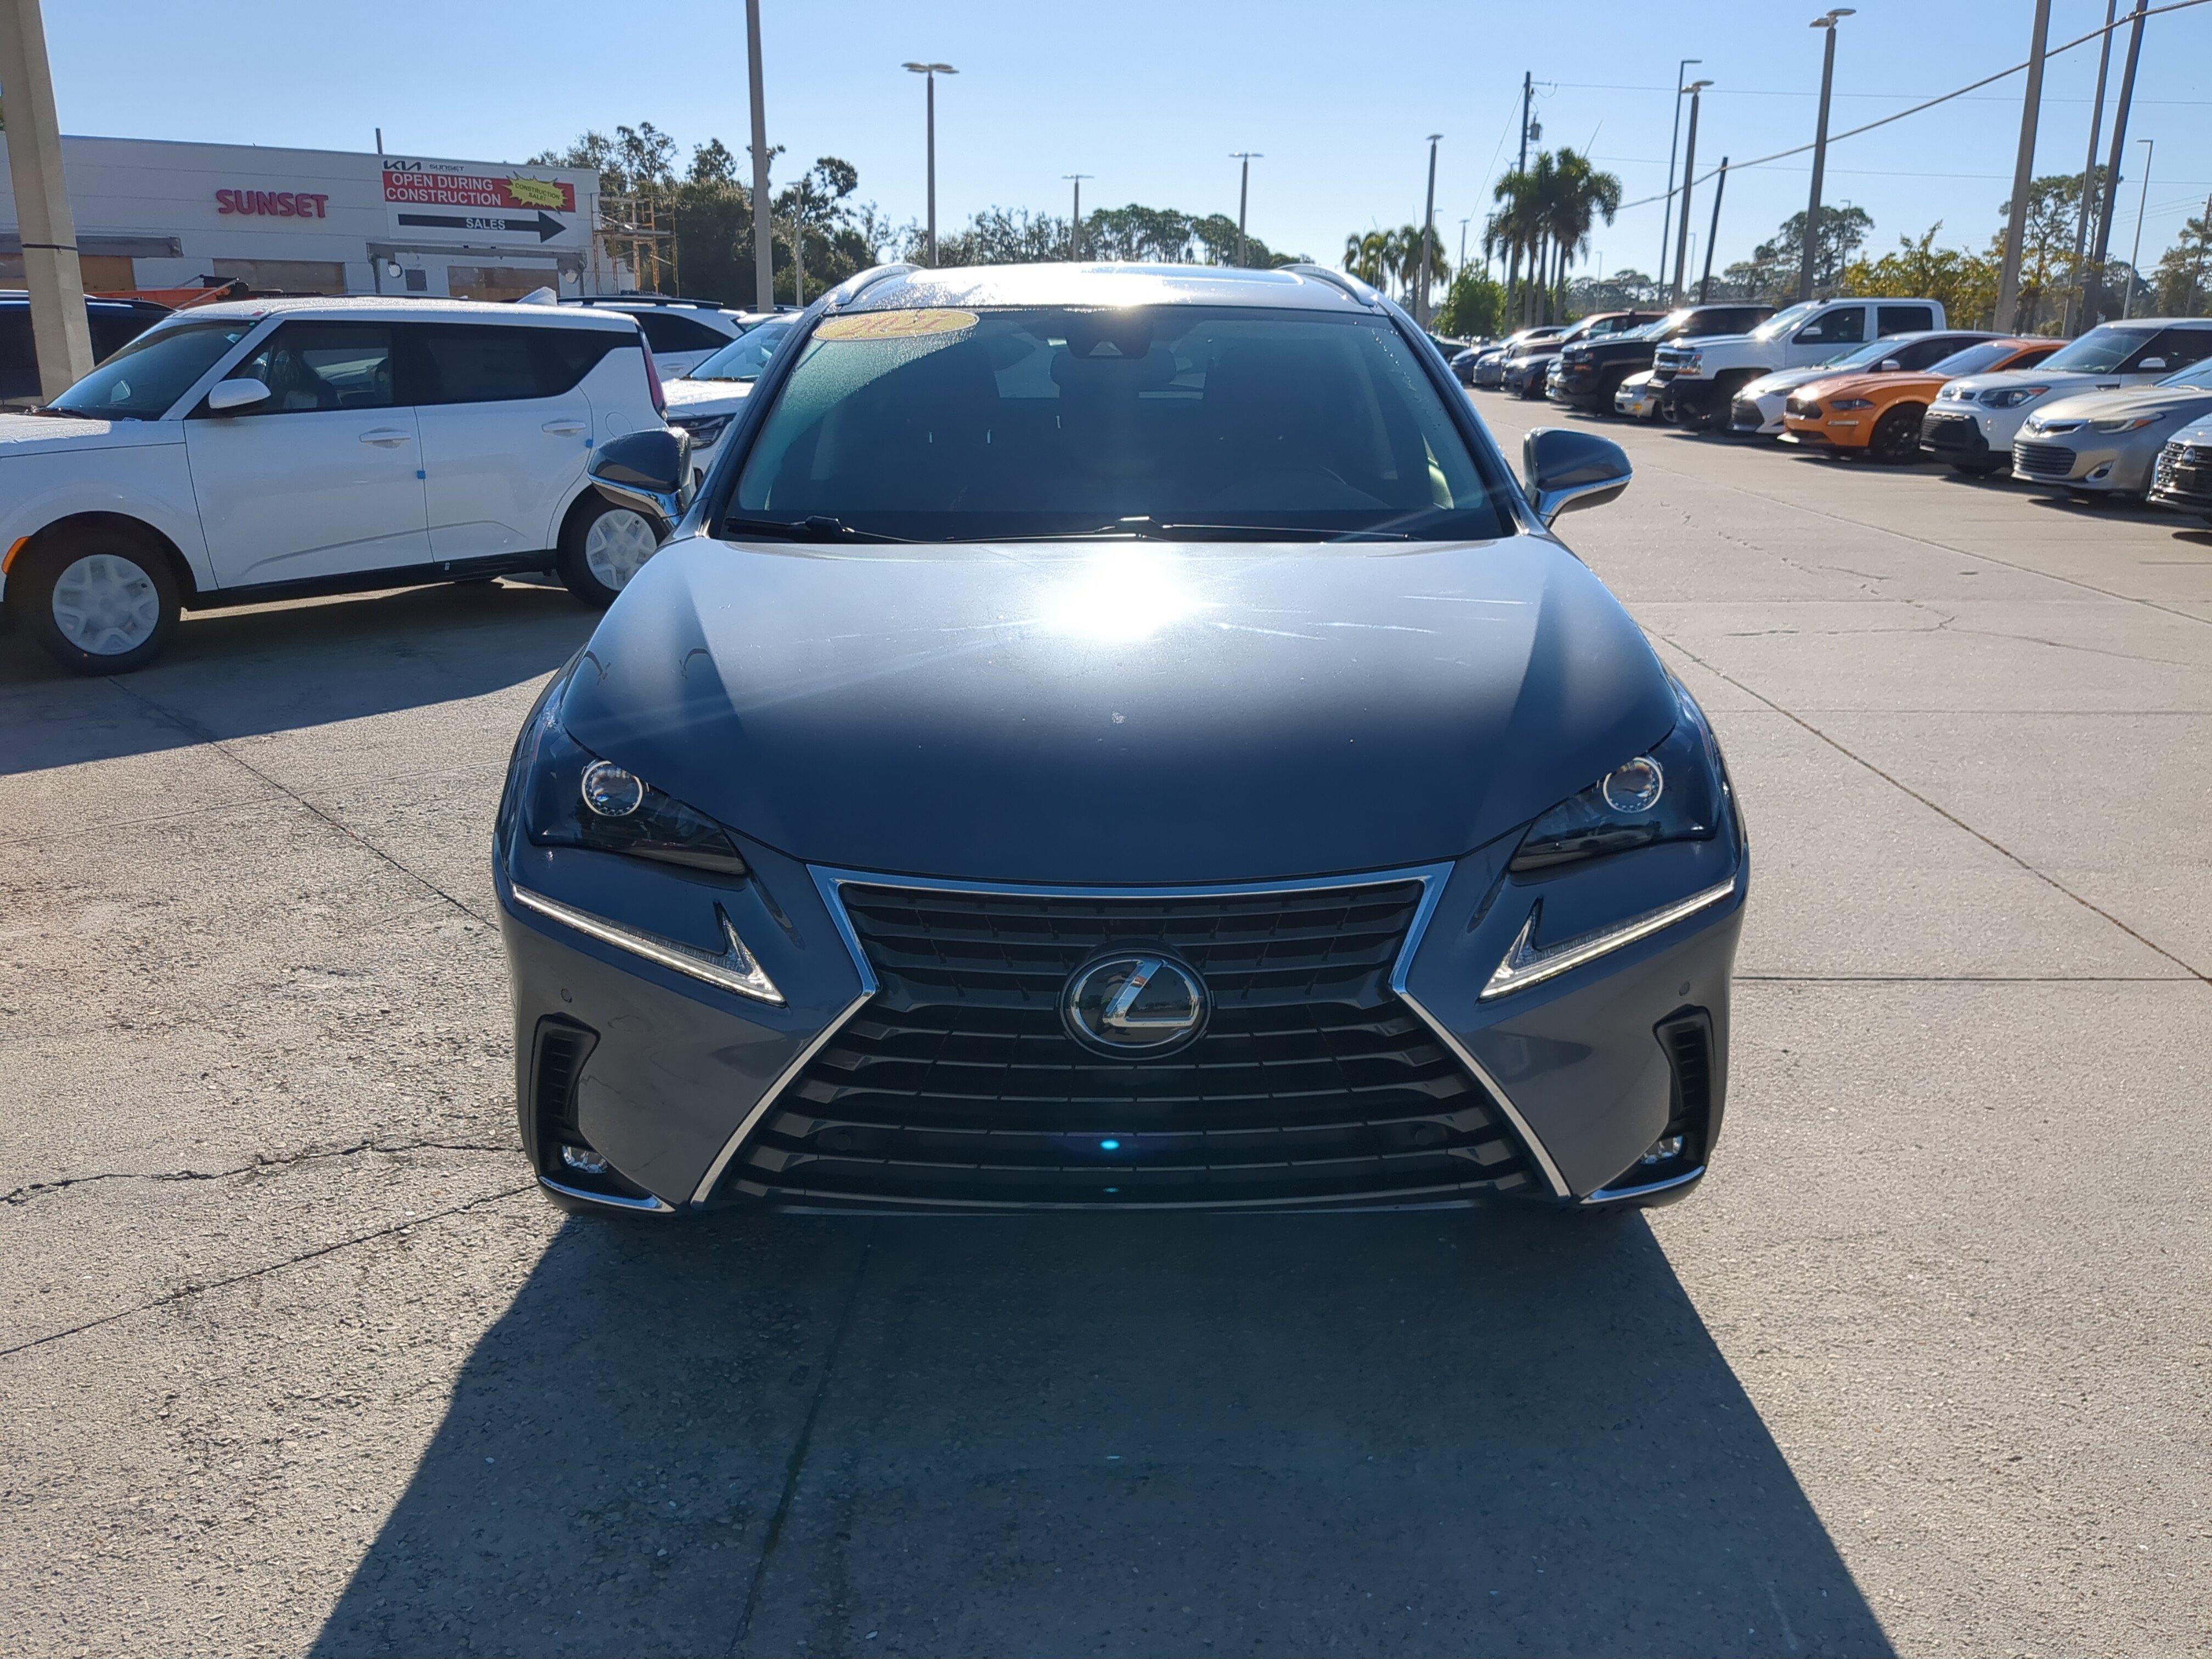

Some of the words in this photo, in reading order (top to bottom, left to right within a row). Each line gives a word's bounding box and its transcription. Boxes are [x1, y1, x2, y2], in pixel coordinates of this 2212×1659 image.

[383, 160, 421, 171] KIA
[392, 173, 433, 187] OPEN
[438, 176, 493, 191] DURING
[386, 188, 501, 206] CONSTRUCTION
[515, 183, 560, 200] CONSTRUCTION
[216, 189, 329, 218] SUNSET
[466, 218, 505, 230] SALES
